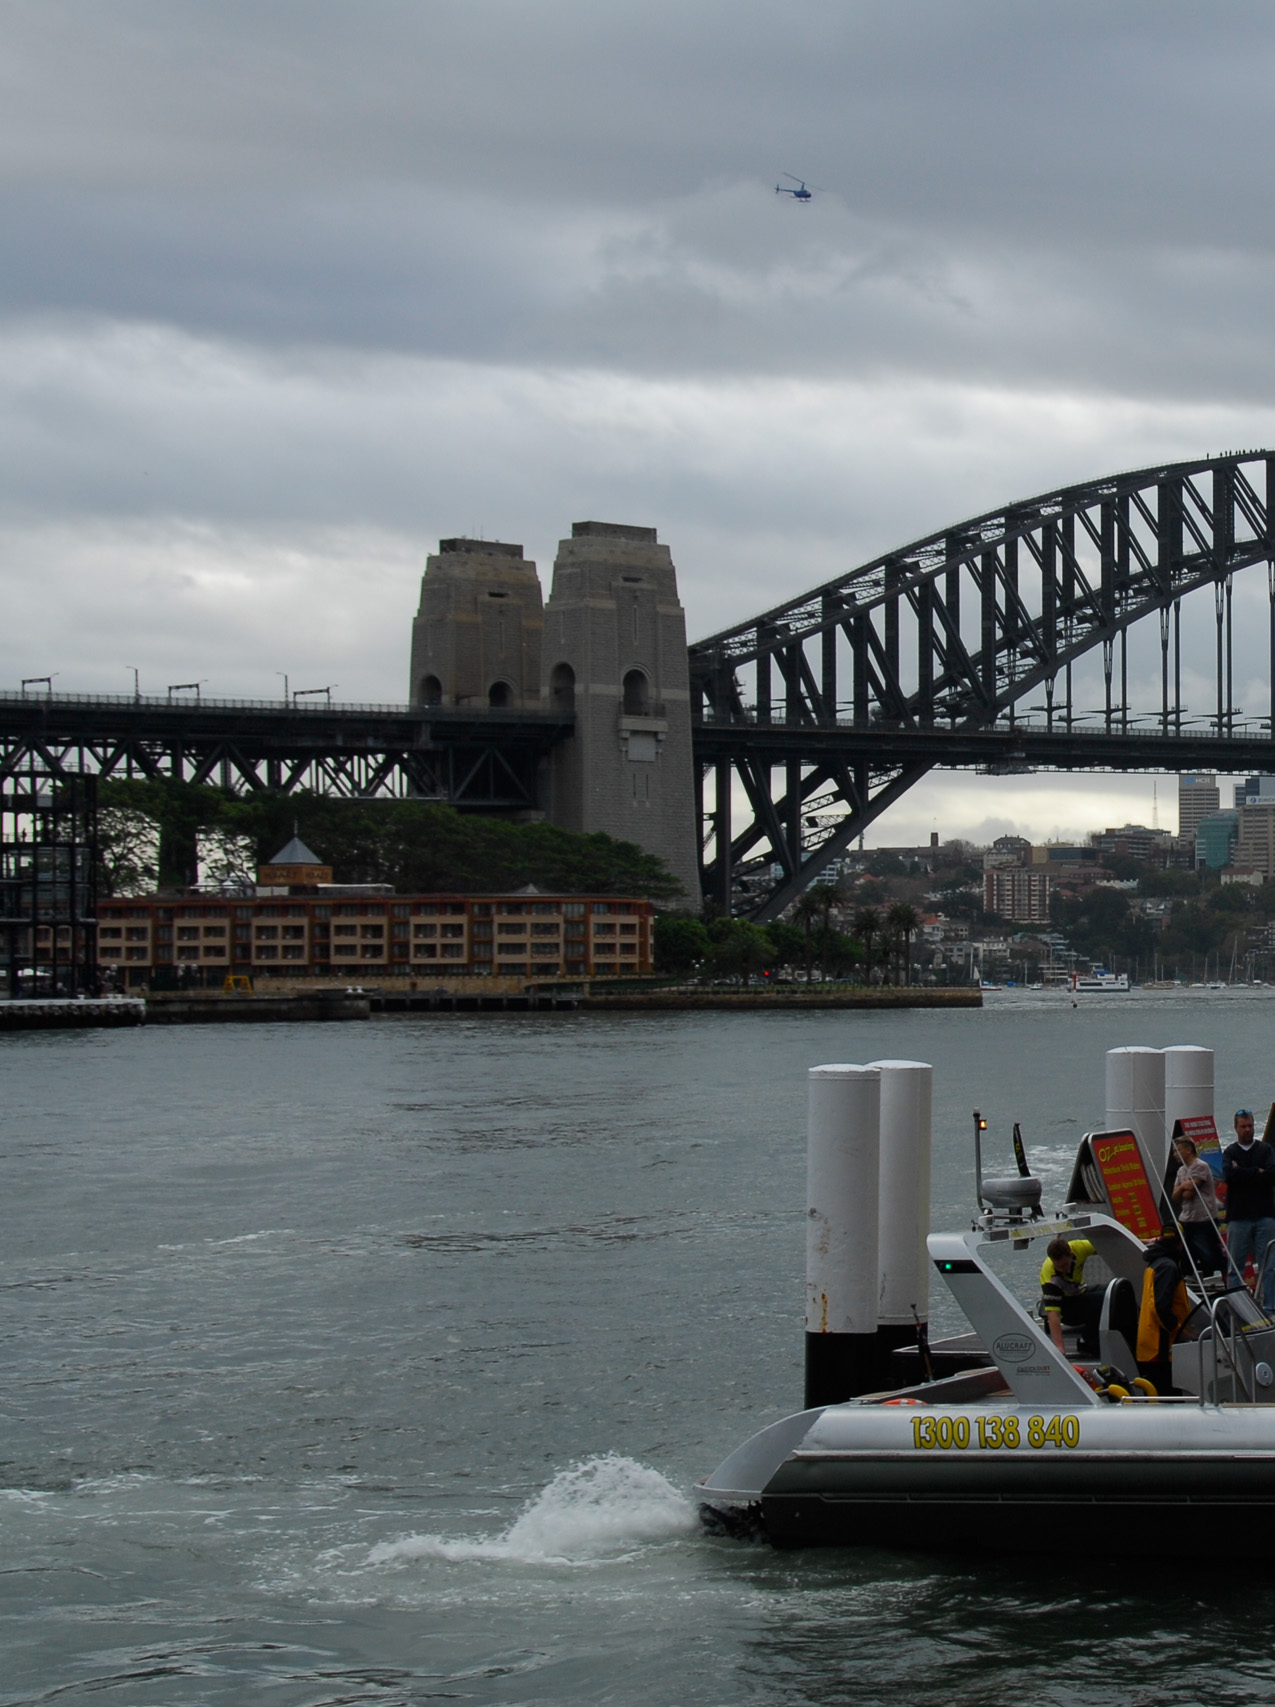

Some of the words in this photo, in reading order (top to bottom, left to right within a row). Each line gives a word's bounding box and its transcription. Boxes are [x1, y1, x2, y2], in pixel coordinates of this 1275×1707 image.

[996, 1342, 1032, 1351] ALUCRAFT
[911, 1414, 970, 1450] 1300
[975, 1414, 1021, 1450] 138
[1027, 1414, 1080, 1450] 840
